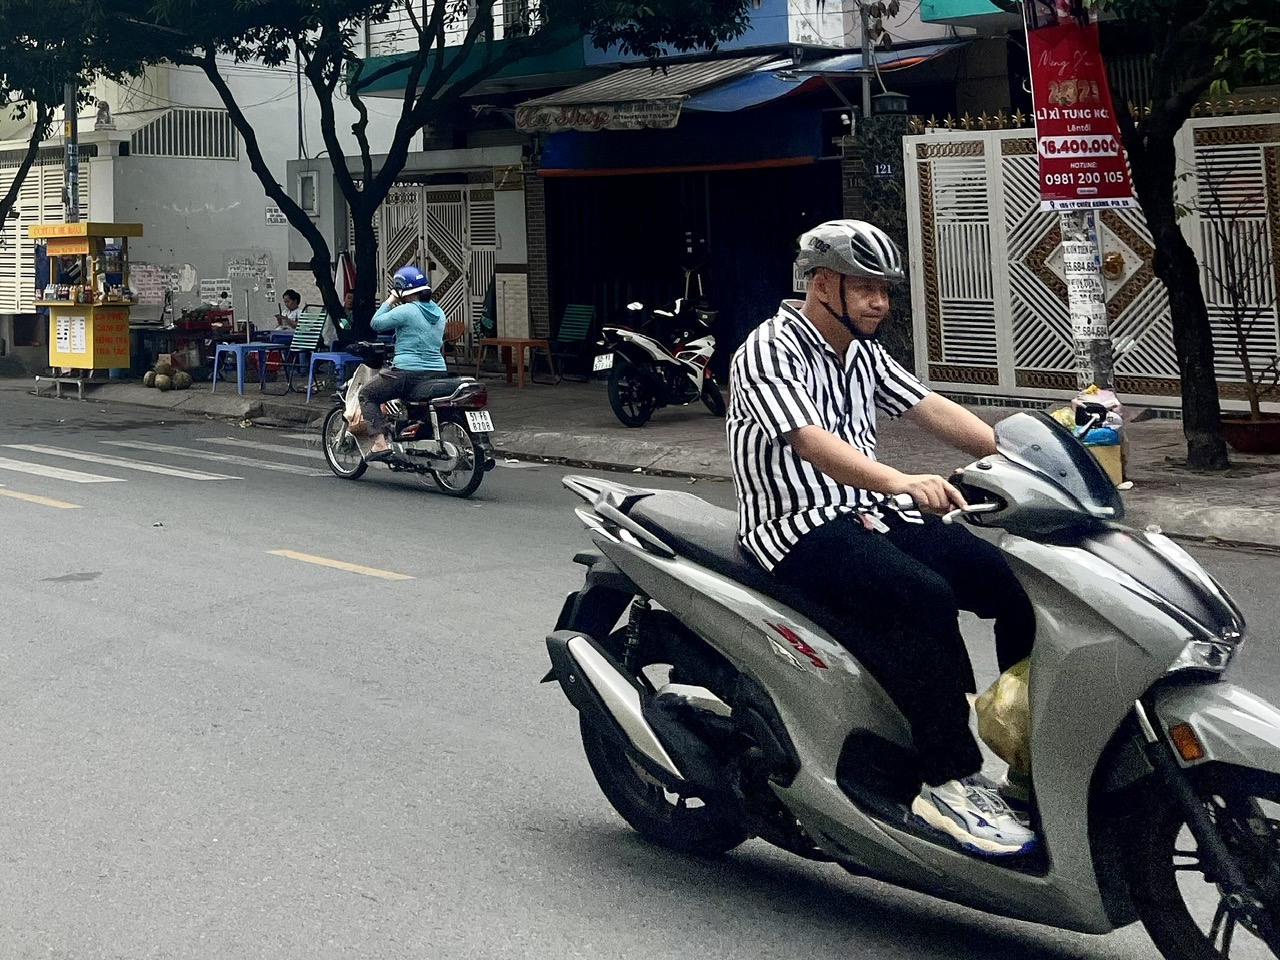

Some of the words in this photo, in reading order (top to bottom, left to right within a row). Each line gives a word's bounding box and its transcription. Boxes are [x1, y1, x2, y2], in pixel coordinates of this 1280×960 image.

[1062, 109, 1092, 120] TUNG
[1042, 139, 1117, 155] 16.400.000
[875, 164, 892, 174] 121
[1045, 172, 1074, 186] 0981
[1078, 172, 1101, 184] 200
[1103, 171, 1124, 183] 105
